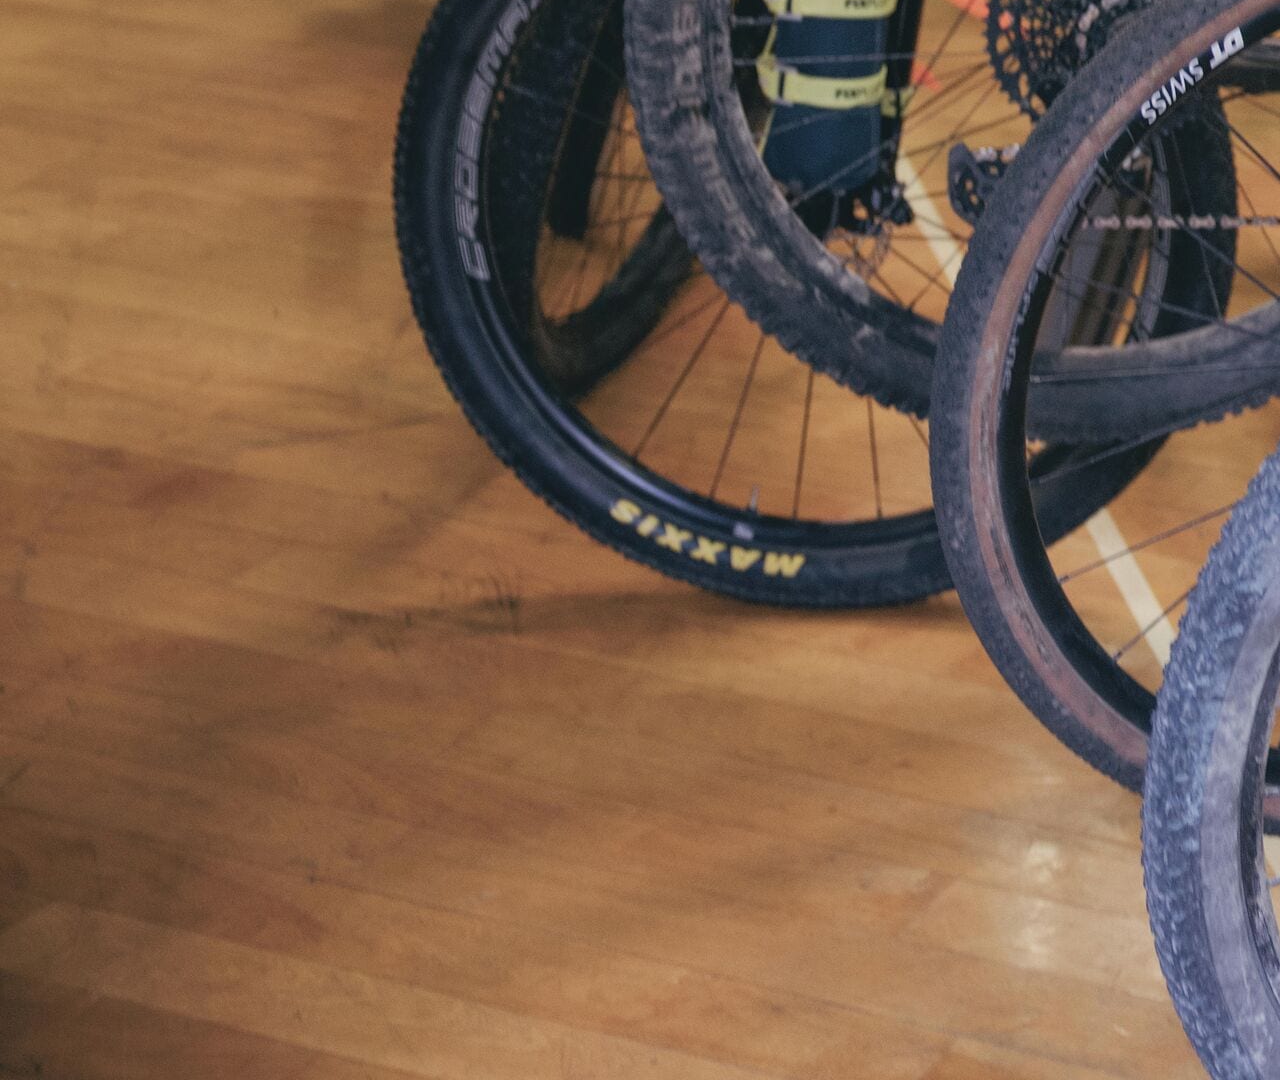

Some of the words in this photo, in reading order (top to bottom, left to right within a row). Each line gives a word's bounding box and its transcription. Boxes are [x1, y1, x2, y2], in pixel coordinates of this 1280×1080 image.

[1209, 26, 1245, 70] DT
[1140, 57, 1204, 126] SWISS
[609, 498, 806, 579] MAXXIS
